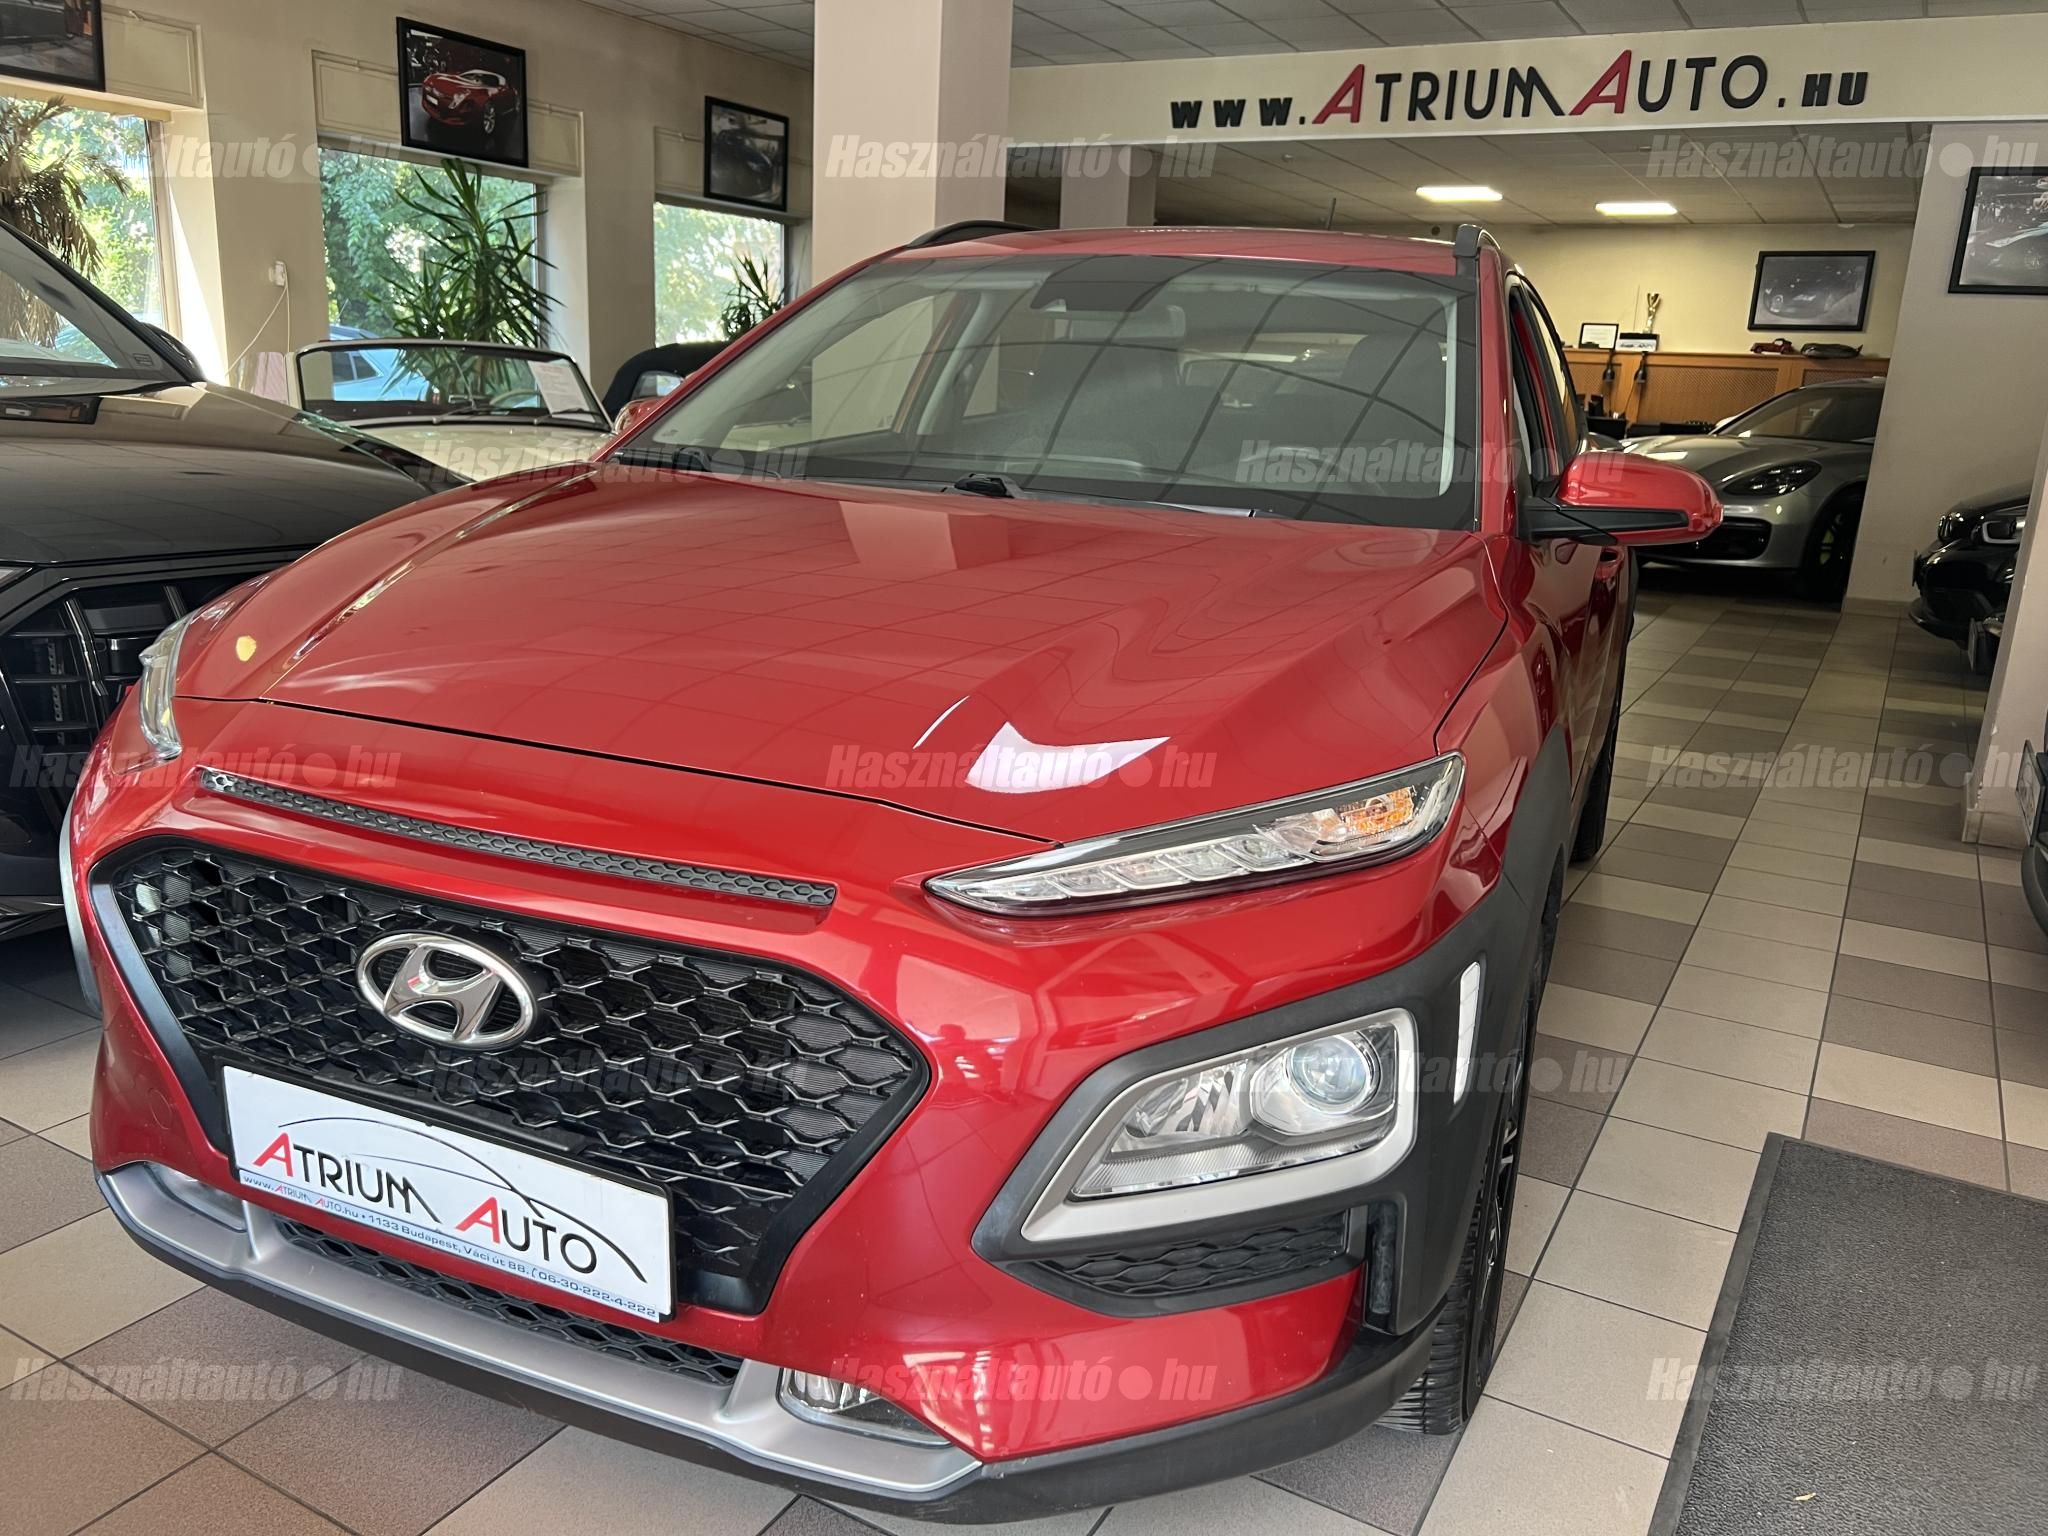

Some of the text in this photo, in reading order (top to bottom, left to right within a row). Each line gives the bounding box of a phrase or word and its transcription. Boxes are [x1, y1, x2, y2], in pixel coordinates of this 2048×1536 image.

[253, 1132, 597, 1275] ATRIUM AUTO
[368, 1214, 400, 1232] 1133
[402, 1225, 462, 1254] Budapest,
[463, 1244, 490, 1262] Váci
